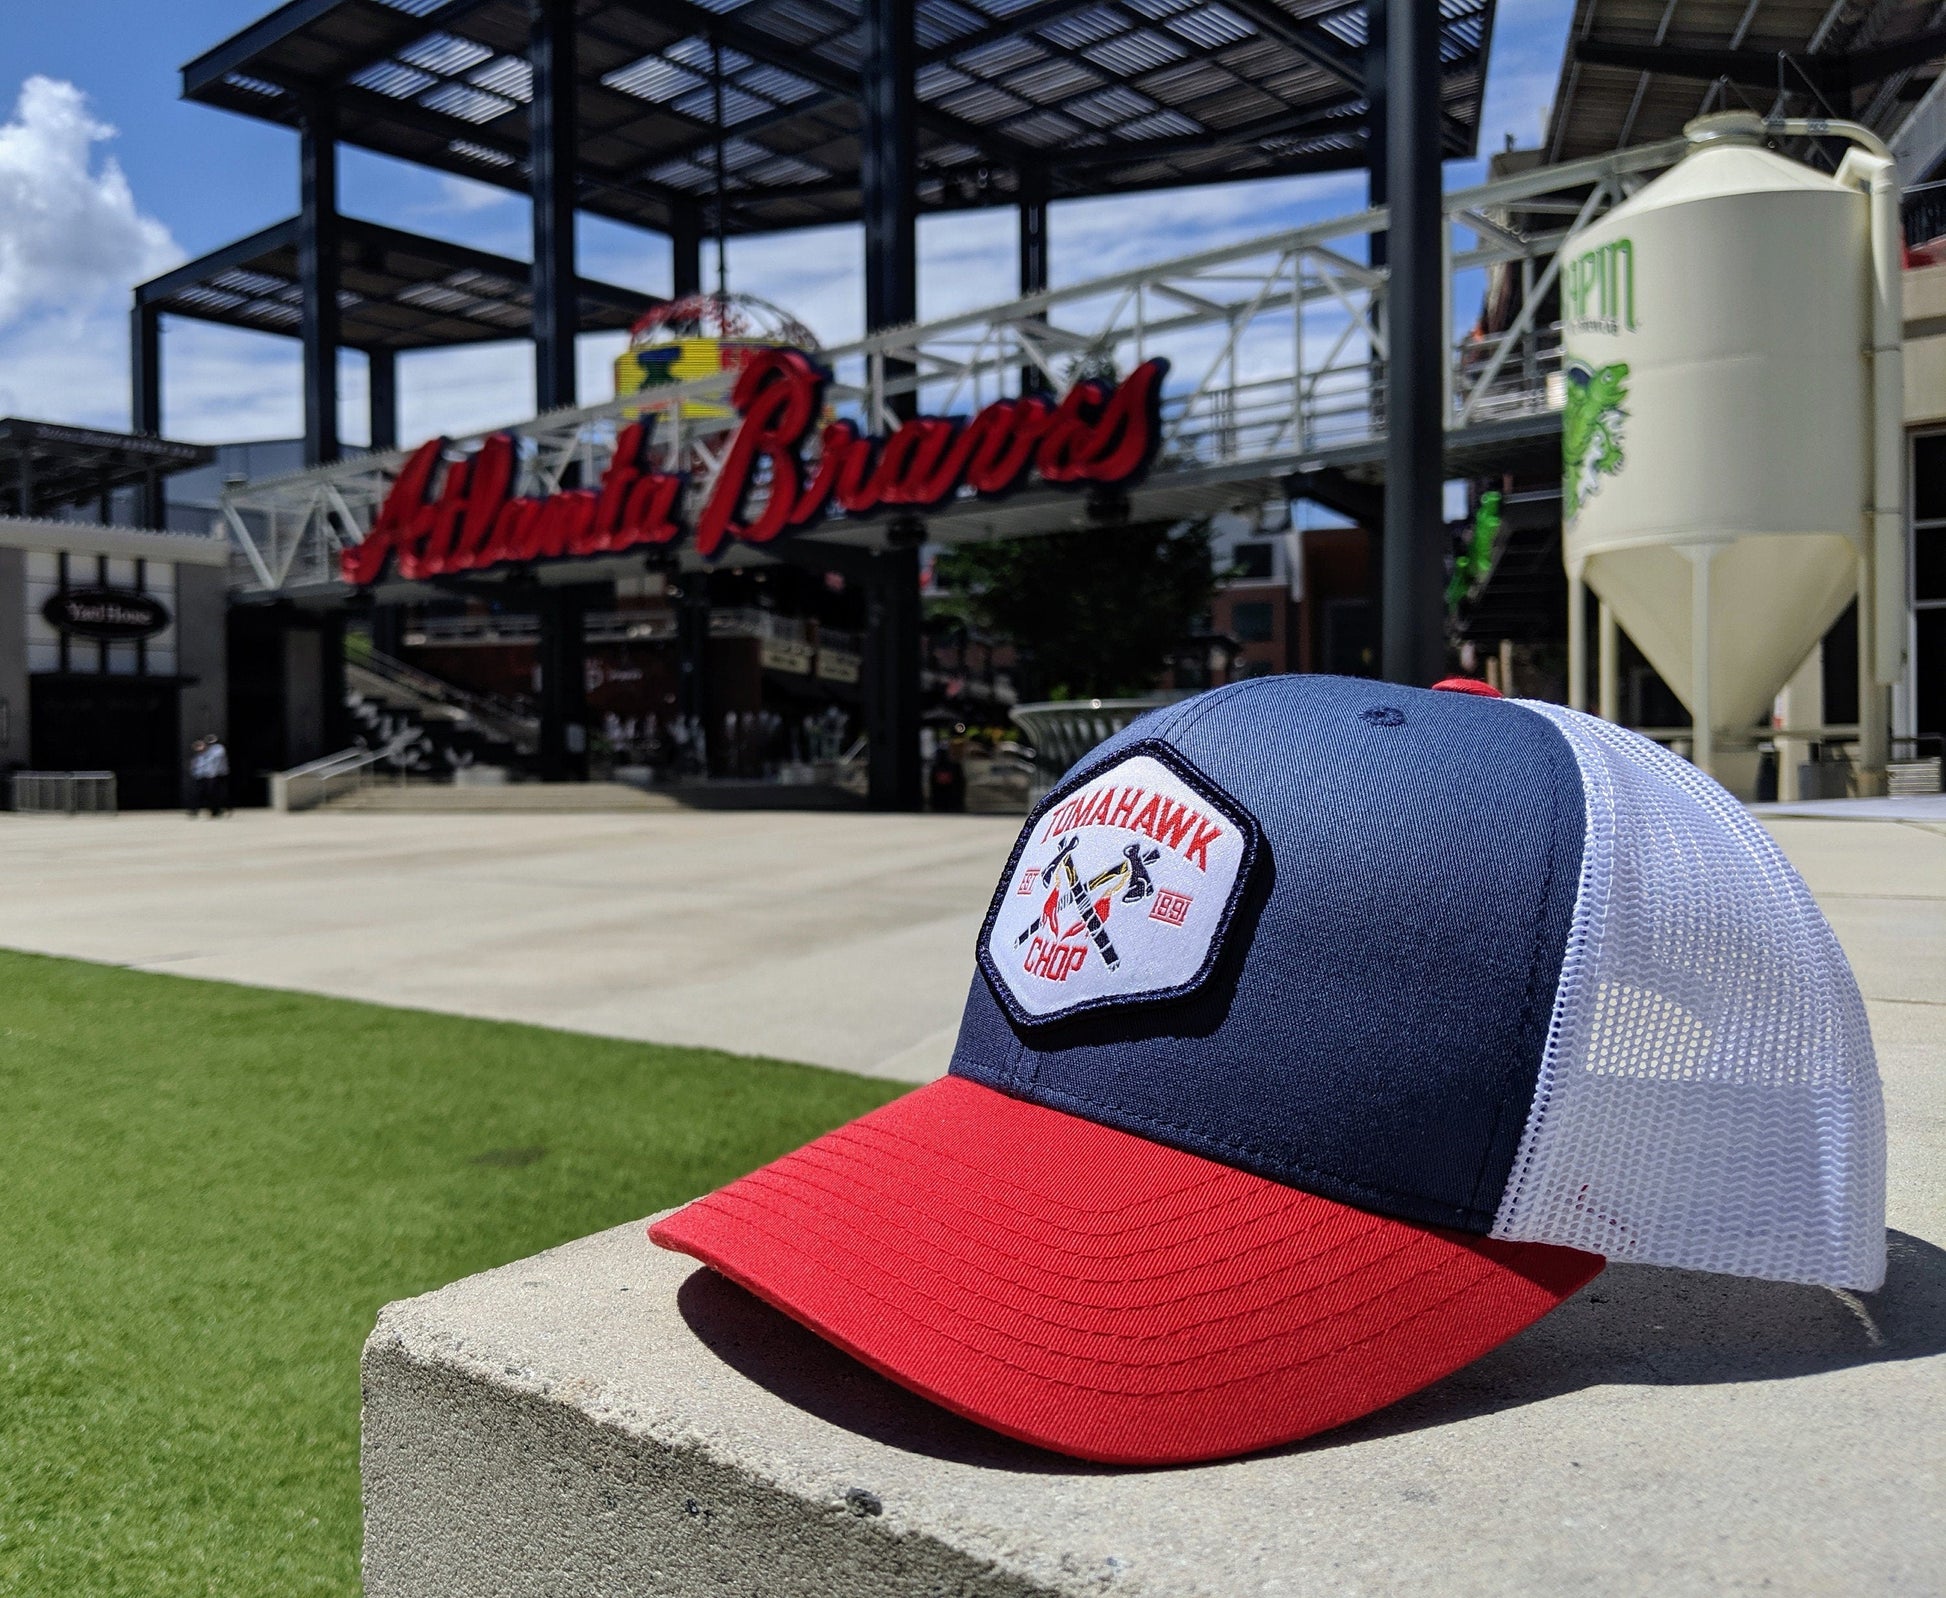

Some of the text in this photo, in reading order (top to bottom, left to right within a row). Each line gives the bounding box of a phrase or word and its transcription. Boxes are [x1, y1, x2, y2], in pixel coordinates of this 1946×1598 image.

[340, 347, 1170, 586] Atlanta Braves
[1041, 786, 1222, 872] TOMAHAWK
[1018, 872, 1191, 923] EST 1991
[1024, 936, 1088, 982] CHOP
